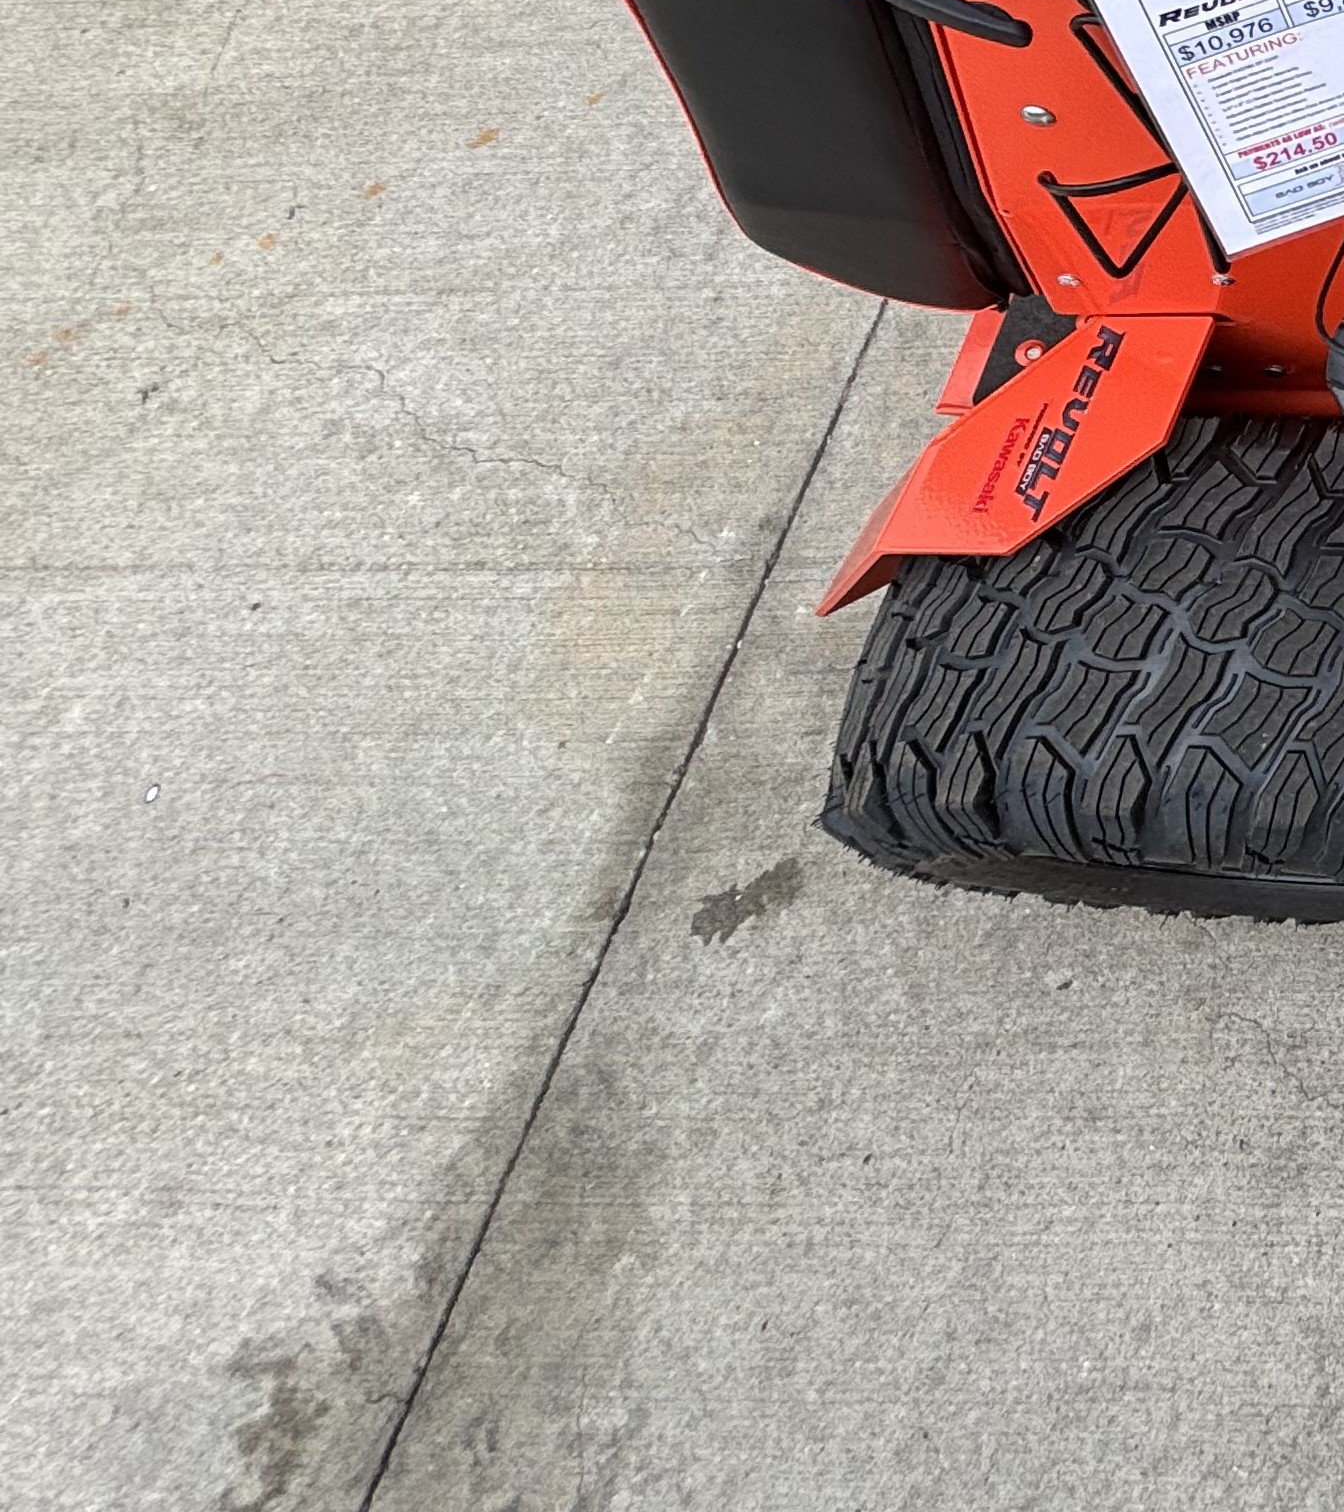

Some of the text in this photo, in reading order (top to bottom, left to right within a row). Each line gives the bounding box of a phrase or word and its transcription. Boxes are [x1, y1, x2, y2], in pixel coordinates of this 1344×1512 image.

[1178, 17, 1274, 61] $10,976
[1205, 11, 1240, 31] MSRP
[1186, 32, 1304, 80] FEATURING:
[1253, 132, 1338, 170] $214.50
[1307, 175, 1335, 188] BOY
[1023, 324, 1127, 523] REVOLT
[971, 417, 1030, 514] Kawasaki
[1019, 433, 1051, 491] BAD BOY
